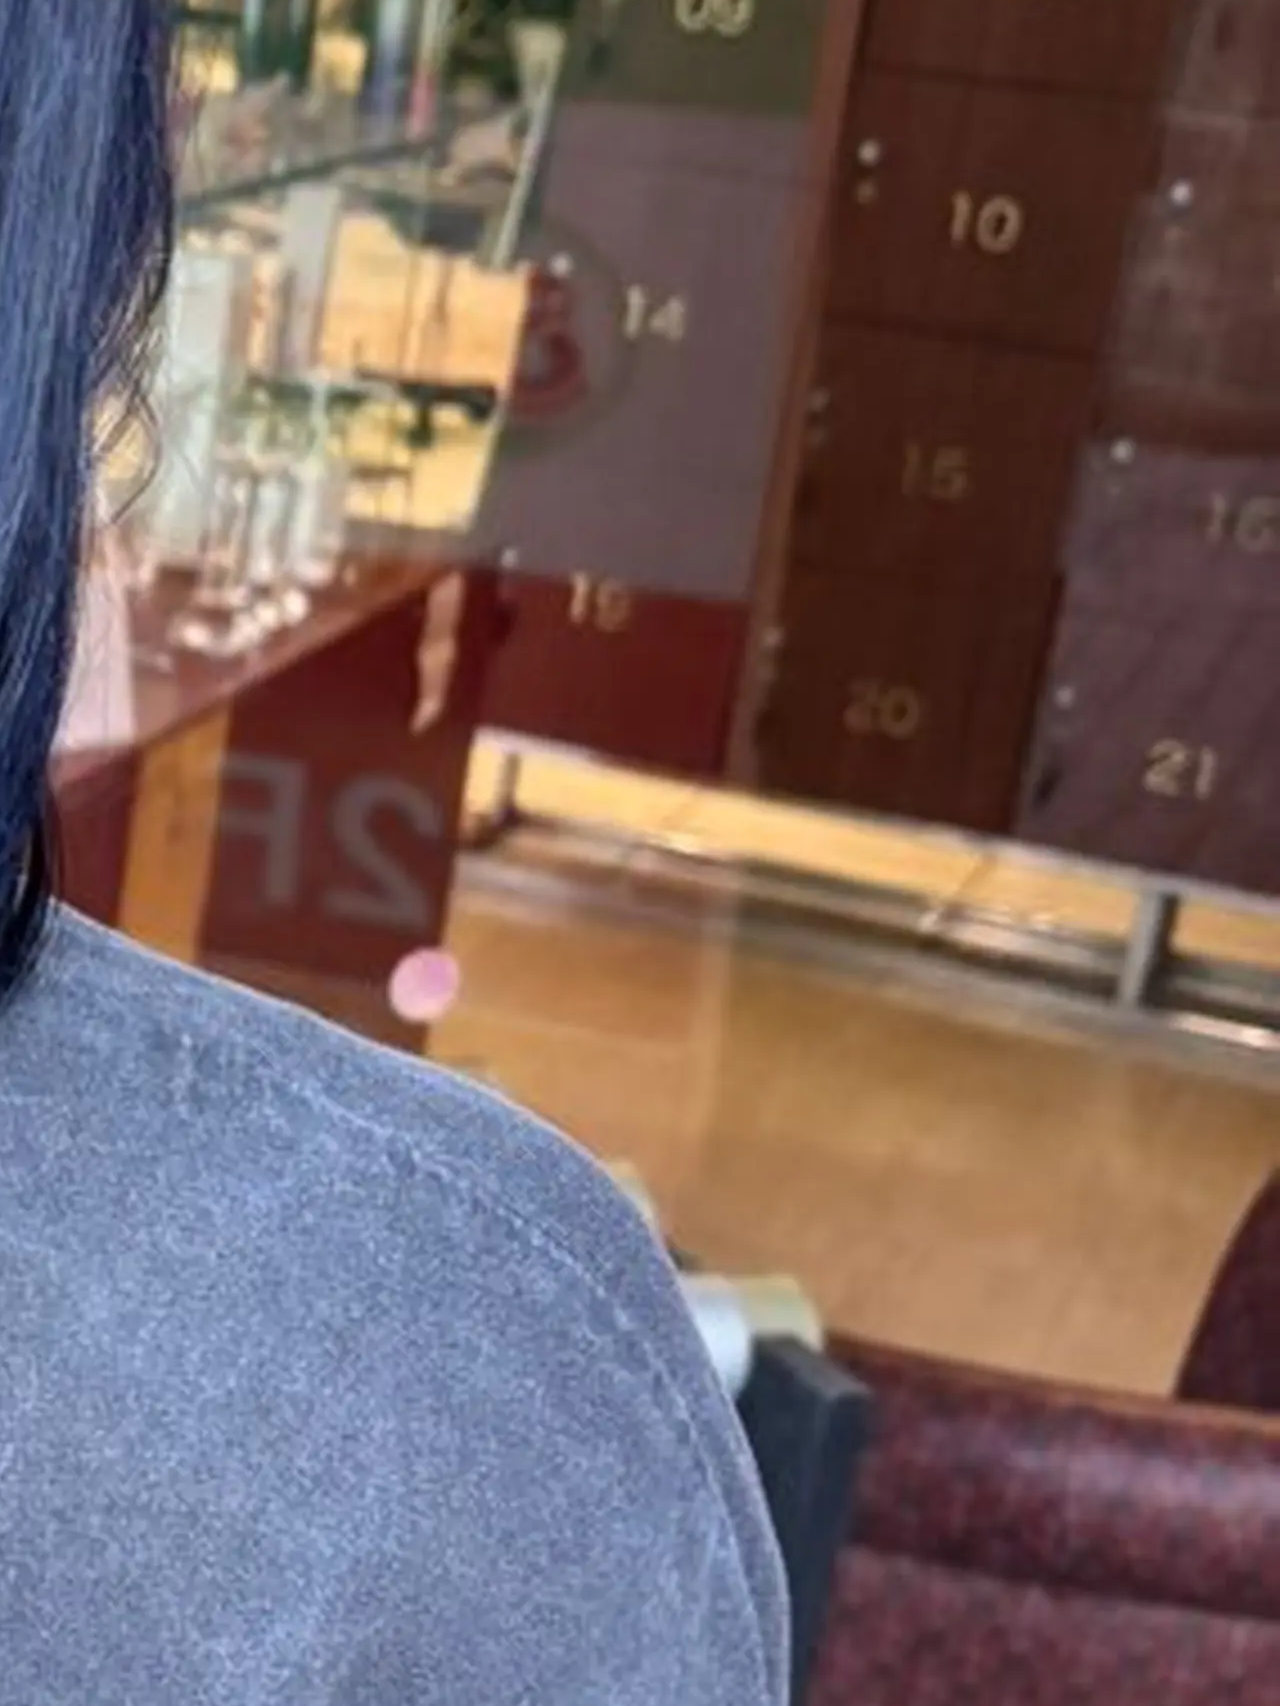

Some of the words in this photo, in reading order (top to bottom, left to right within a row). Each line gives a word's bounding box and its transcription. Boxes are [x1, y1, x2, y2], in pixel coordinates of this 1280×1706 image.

[949, 194, 1022, 254] 10
[623, 283, 687, 342] 14
[1143, 739, 1219, 801] 21
